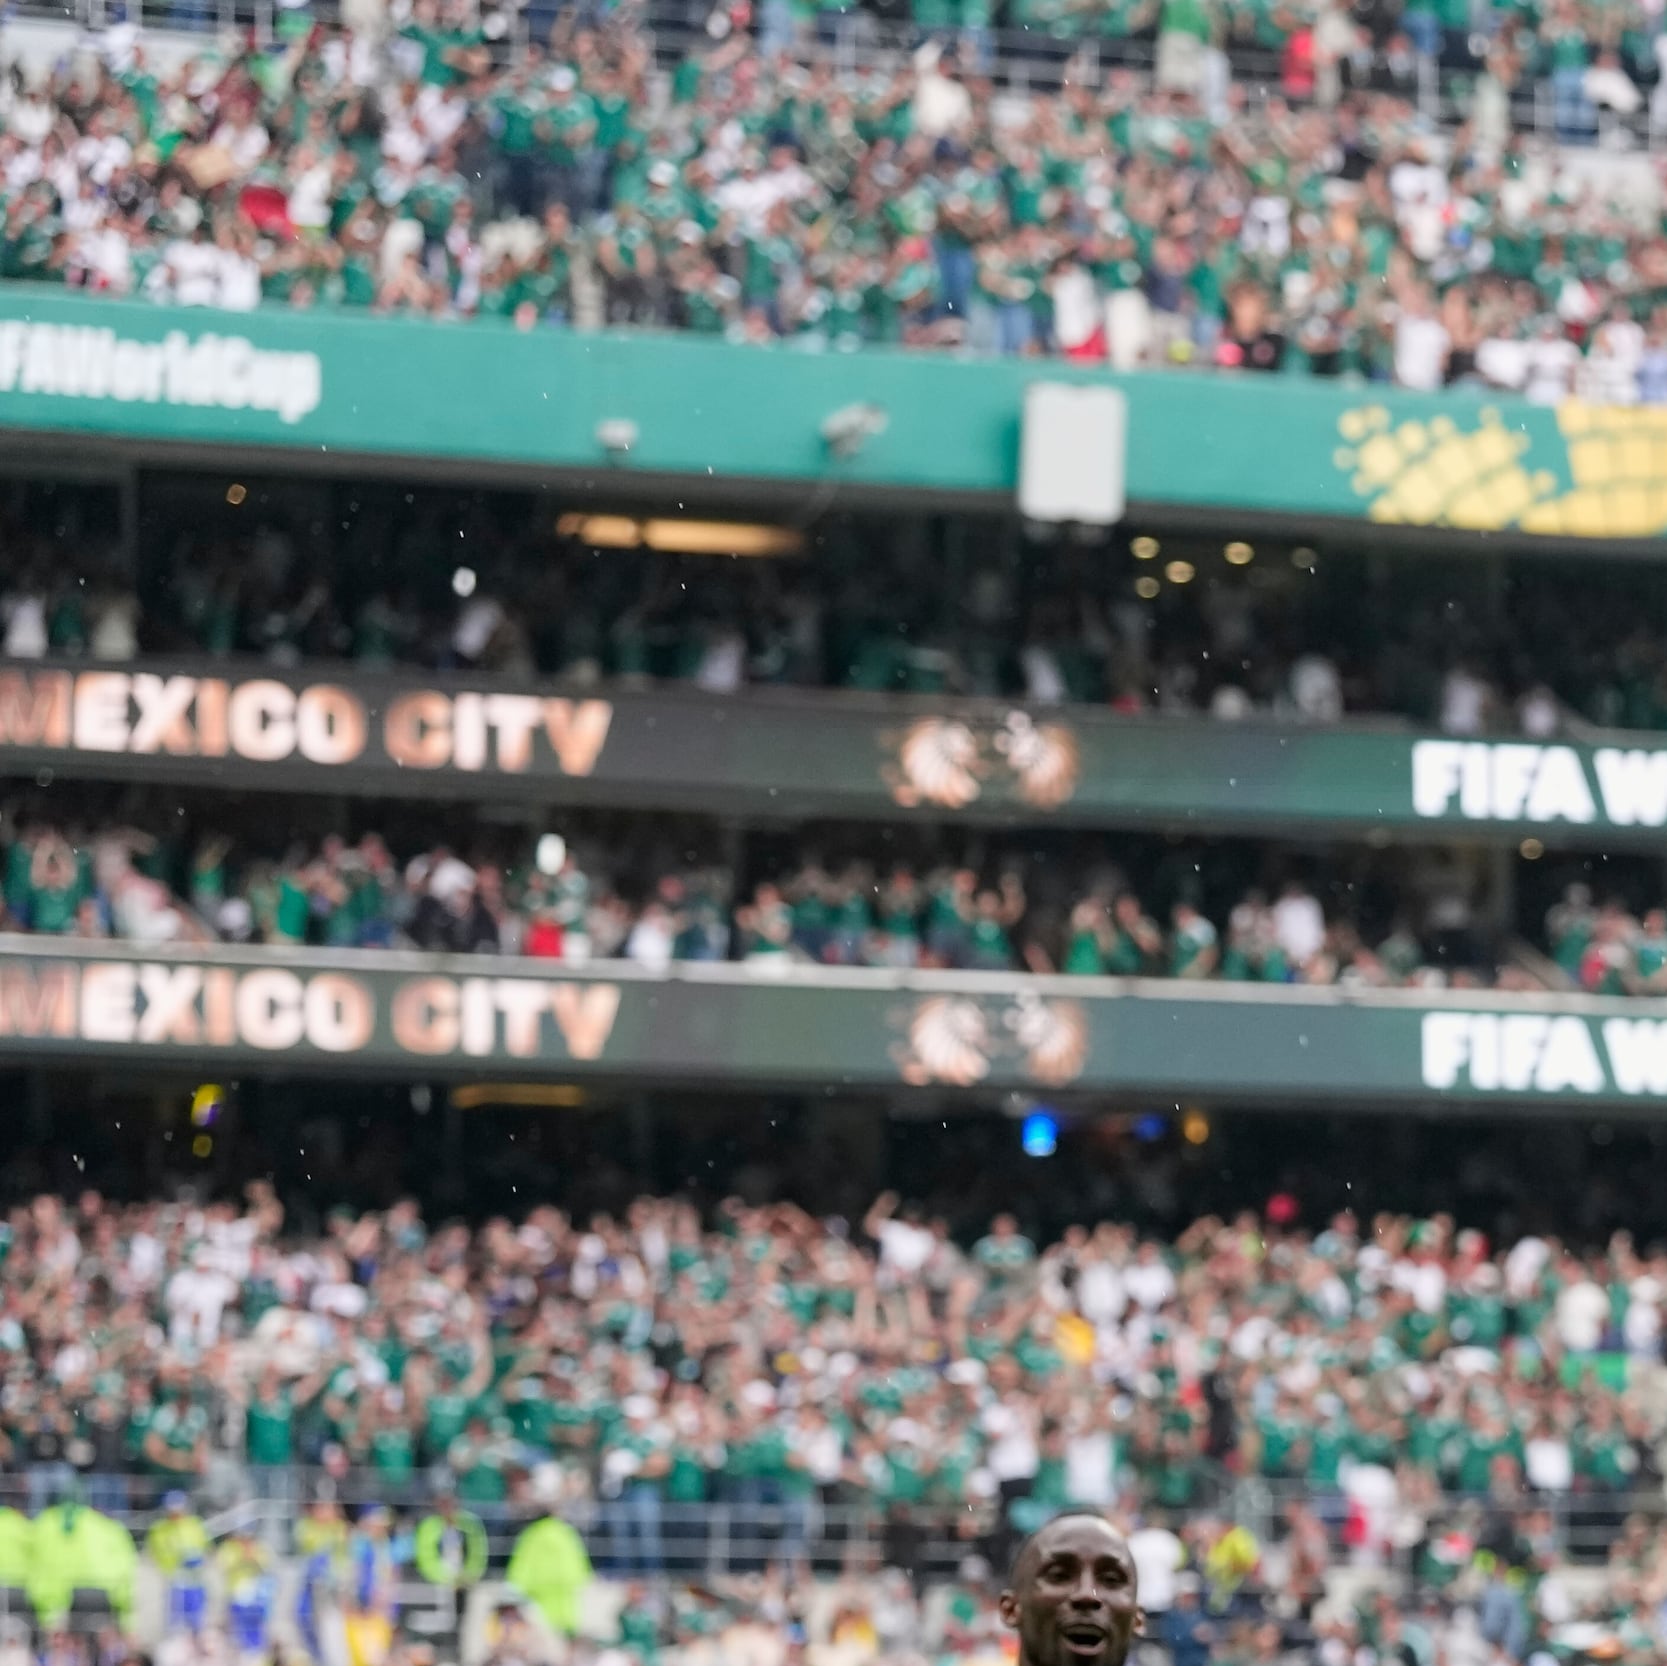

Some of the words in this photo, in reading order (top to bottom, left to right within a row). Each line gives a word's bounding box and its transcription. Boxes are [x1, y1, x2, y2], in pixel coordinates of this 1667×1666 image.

[0, 667, 367, 764] MEXICO
[383, 690, 614, 776] CITY
[1411, 738, 1597, 825] FIFA
[0, 961, 376, 1052] MEXICO
[391, 974, 621, 1060] CITY
[1420, 1012, 1605, 1095] FIFA
